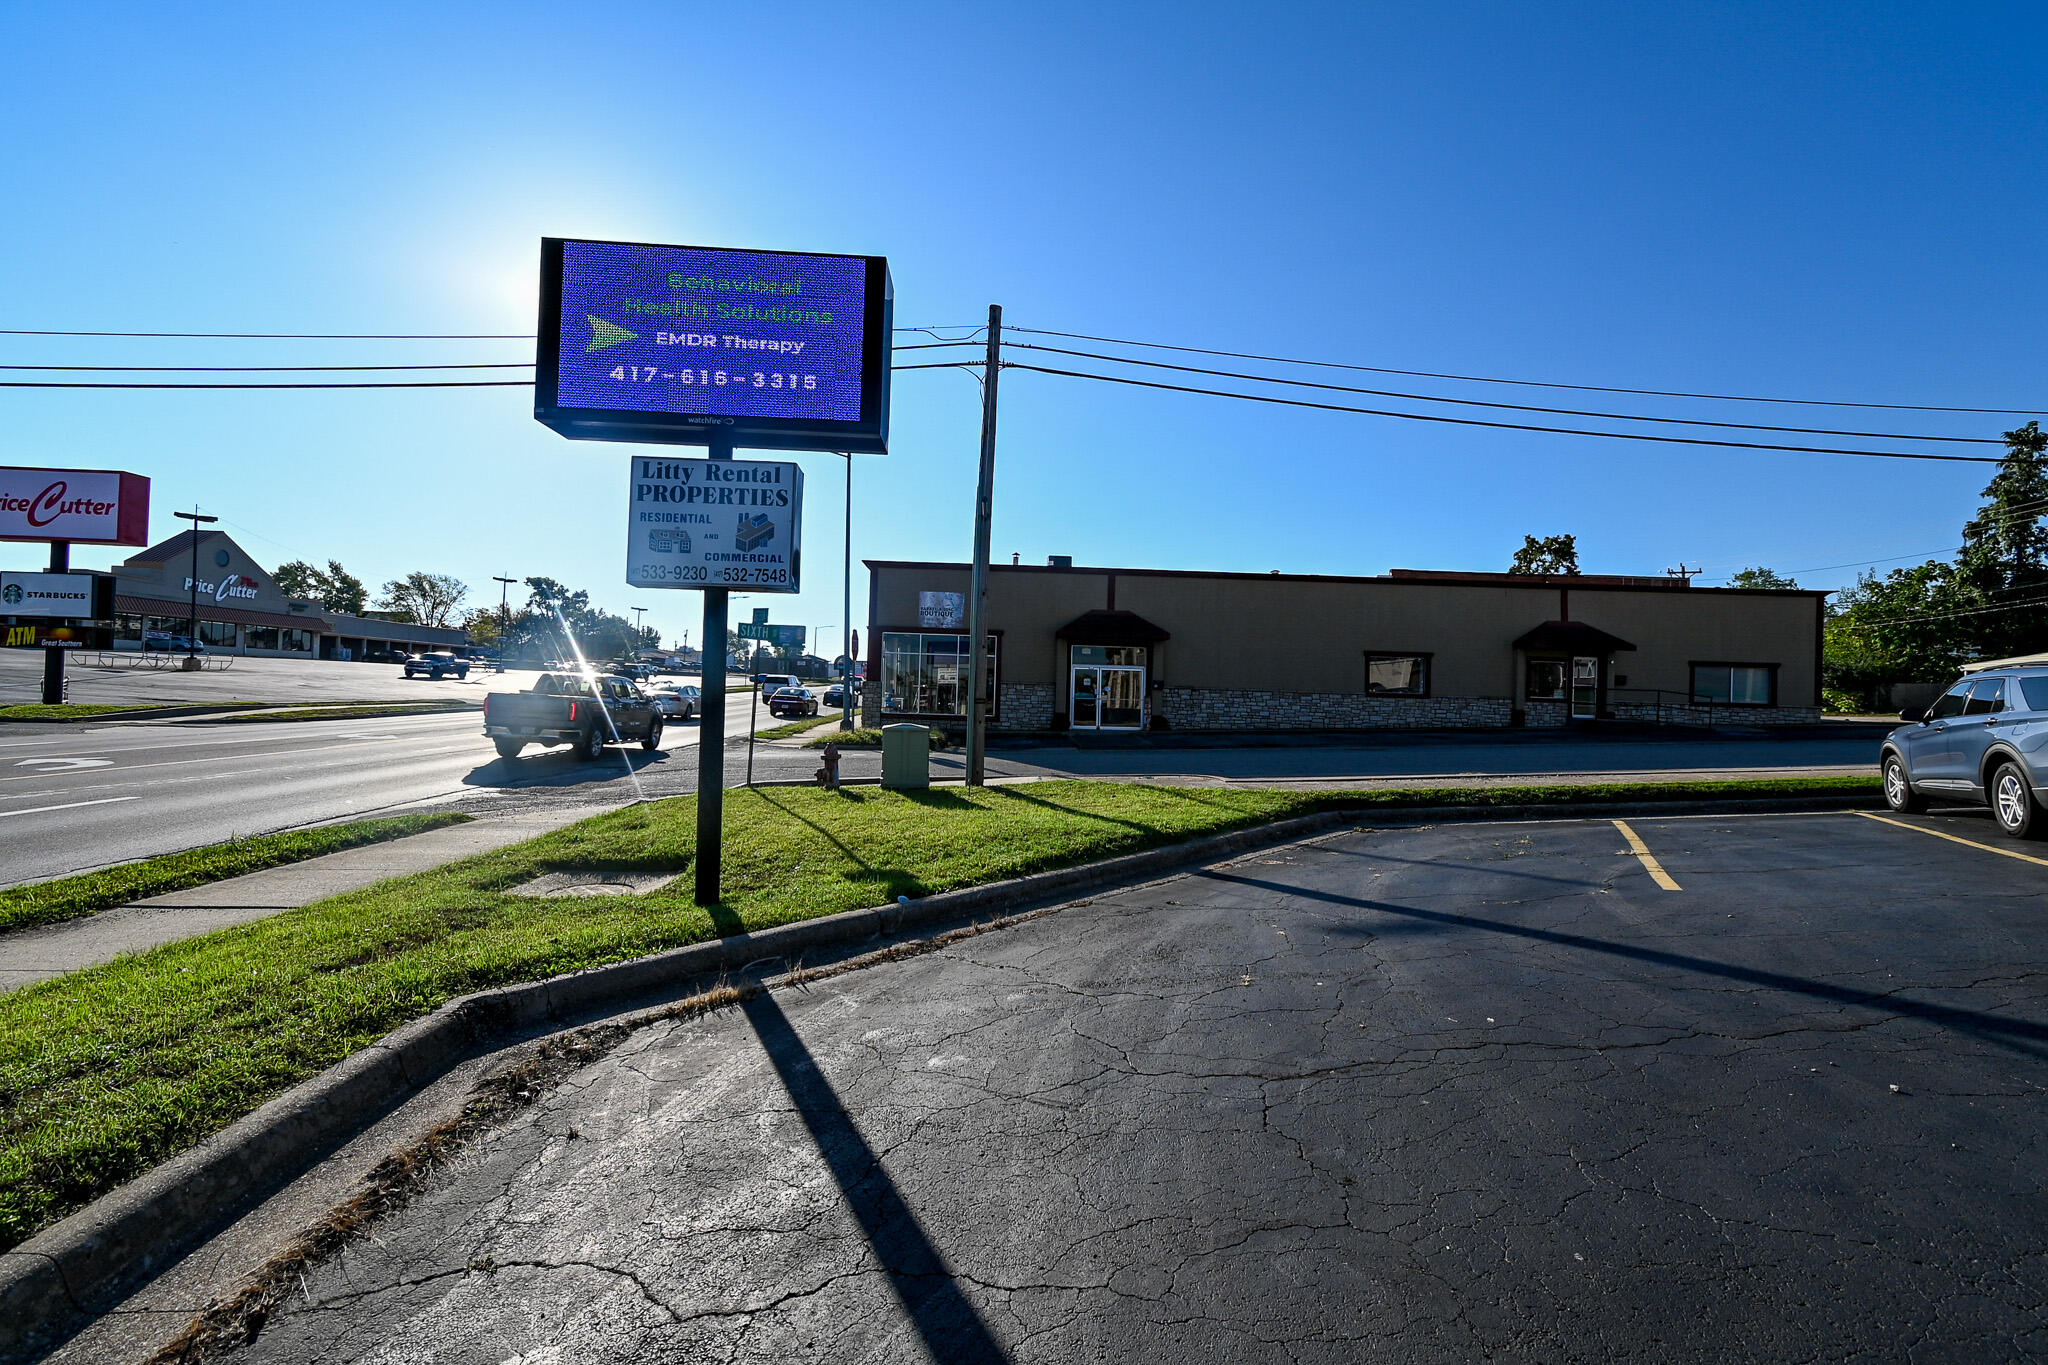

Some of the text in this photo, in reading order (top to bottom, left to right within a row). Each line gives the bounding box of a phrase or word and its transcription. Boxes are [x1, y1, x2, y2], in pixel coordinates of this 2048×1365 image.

[667, 271, 802, 296] Behavioral
[625, 298, 834, 325] Health Solutions
[656, 331, 805, 355] EMDR Therapy
[688, 415, 722, 425] watchfire
[641, 461, 782, 485] Litty Rental
[0, 481, 116, 528] ice Cutter
[636, 484, 789, 508] PROPERTIES
[639, 511, 713, 525] RESIDENTIAL
[704, 552, 785, 564] COMMERCIAL
[641, 564, 708, 581] 533-9230
[722, 567, 788, 583] 532-7548
[27, 592, 86, 600] STARBUCKS
[215, 574, 258, 602] Cutter
[6, 626, 36, 647] ATM
[740, 624, 769, 639] SIXTH
[41, 638, 83, 648] Great Southern
